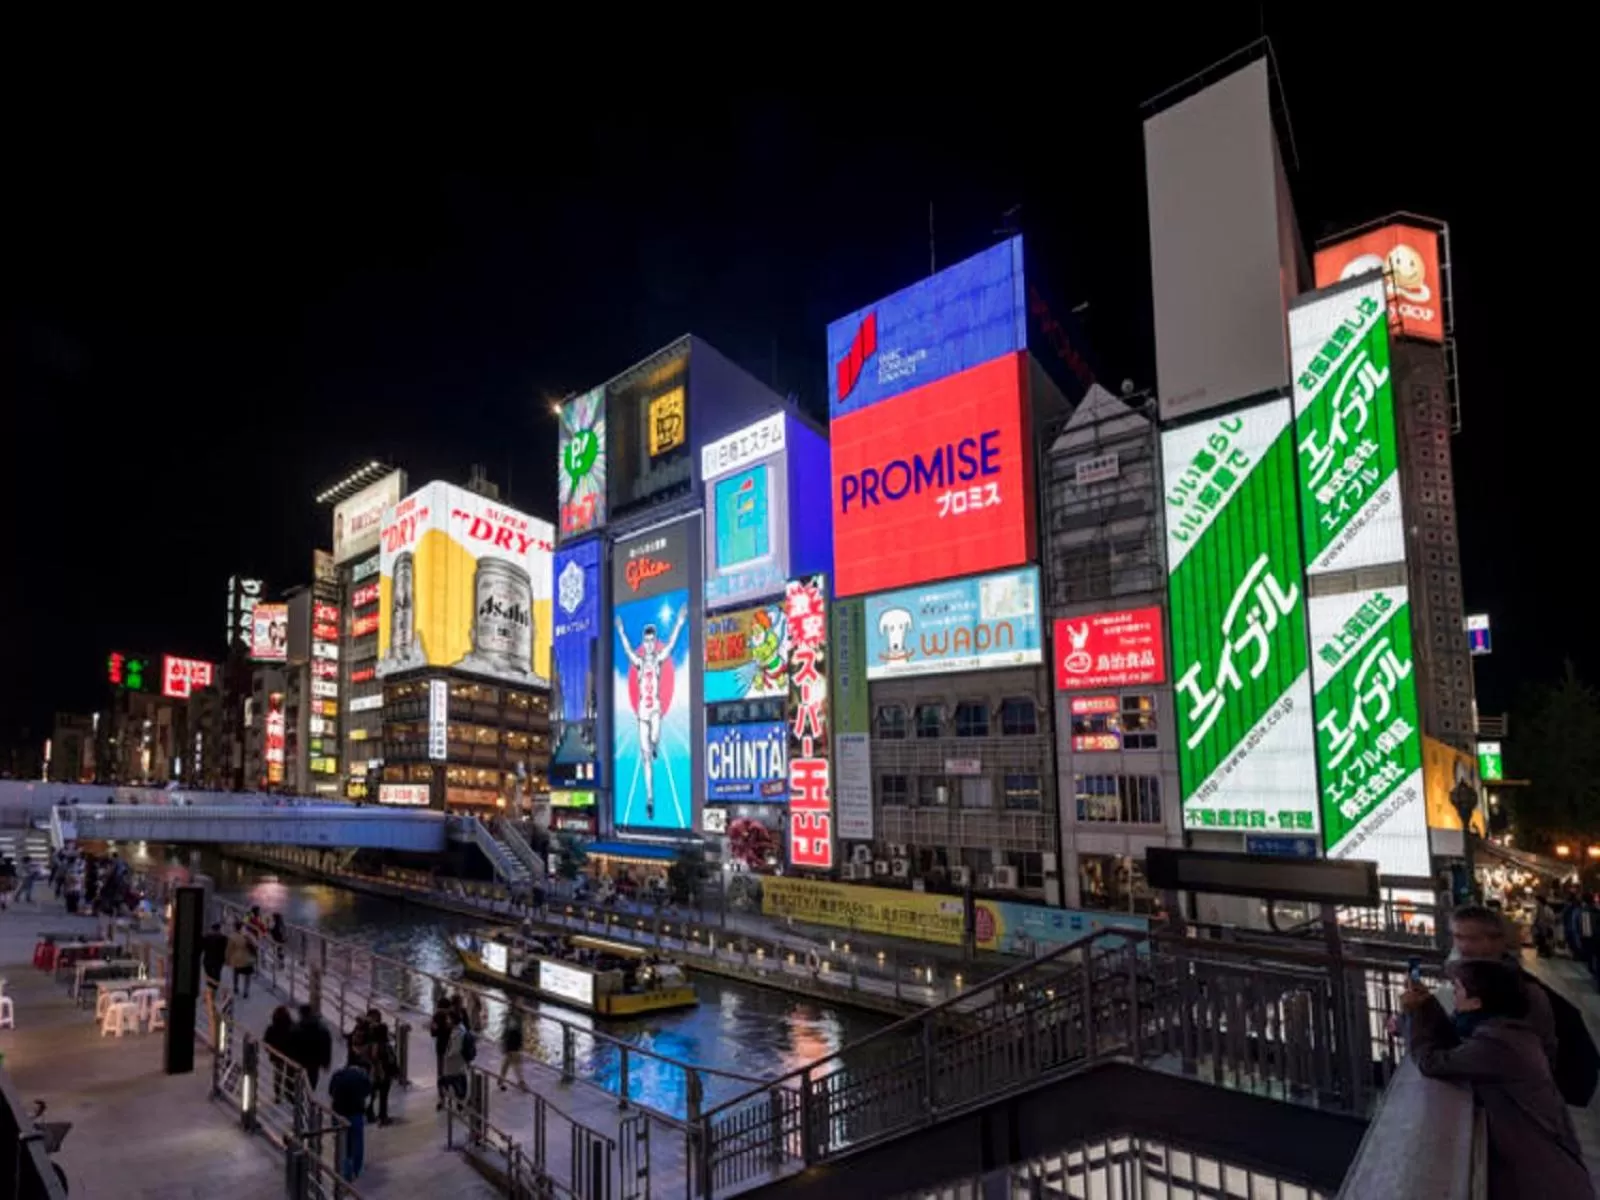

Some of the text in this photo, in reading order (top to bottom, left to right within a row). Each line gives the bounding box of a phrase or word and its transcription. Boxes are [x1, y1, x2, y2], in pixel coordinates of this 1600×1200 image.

[841, 430, 1001, 514] PROMISE
[1298, 350, 1390, 490] エイブル
[936, 482, 1002, 518] プロミス
[1176, 552, 1299, 750] エイブル
[1317, 637, 1412, 769] エイブル
